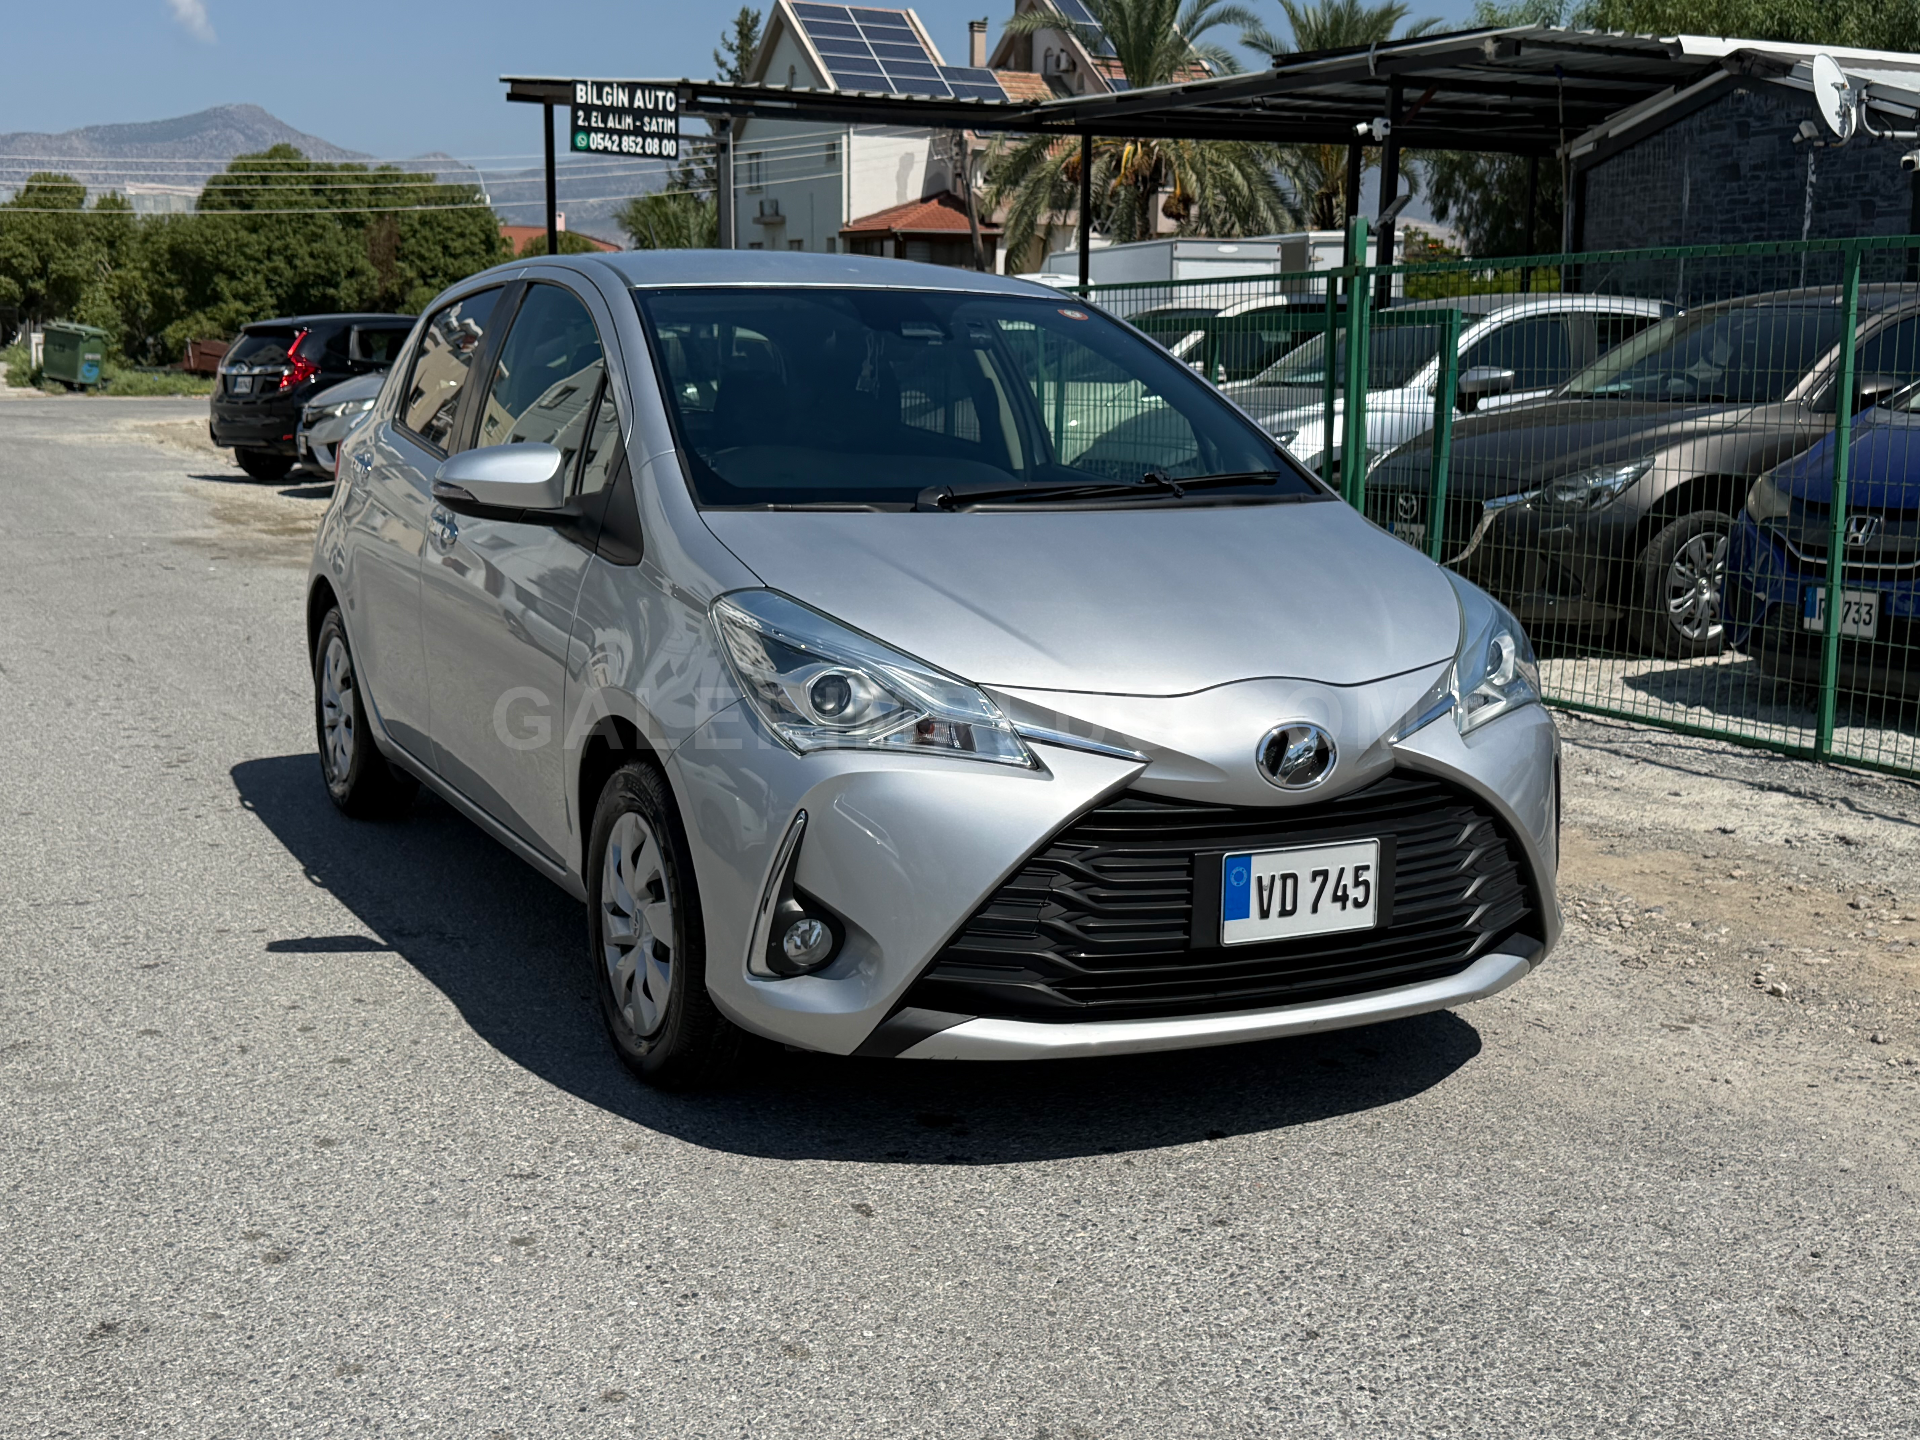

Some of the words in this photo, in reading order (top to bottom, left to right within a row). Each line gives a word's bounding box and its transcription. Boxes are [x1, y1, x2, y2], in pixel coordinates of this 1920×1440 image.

[576, 81, 629, 108] BİLGİN
[633, 88, 677, 112] AUTO
[577, 109, 588, 127] 2.
[591, 111, 605, 128] EL
[607, 112, 634, 131] ALIM
[643, 115, 676, 134] SATIM
[589, 131, 620, 152] 0542
[621, 134, 643, 154] 852
[645, 136, 660, 156] 08
[661, 138, 677, 157] 00
[1842, 601, 1874, 626] 733
[1256, 872, 1299, 920] VD
[1310, 863, 1371, 915] 745
